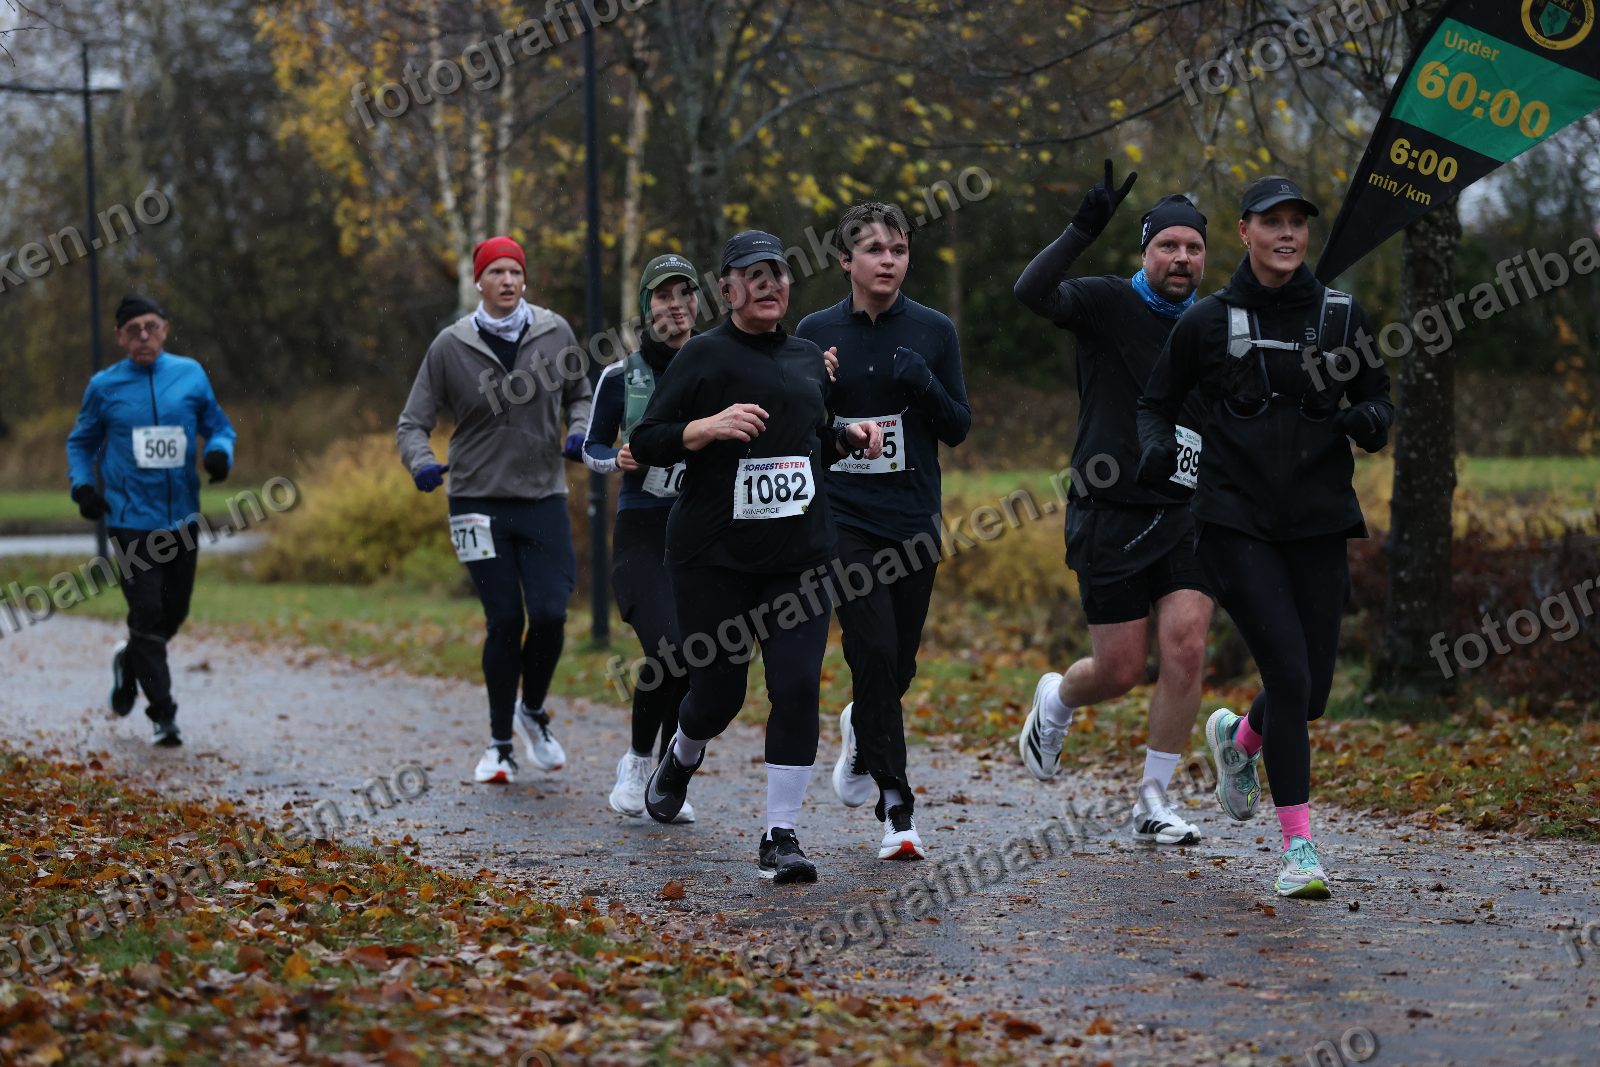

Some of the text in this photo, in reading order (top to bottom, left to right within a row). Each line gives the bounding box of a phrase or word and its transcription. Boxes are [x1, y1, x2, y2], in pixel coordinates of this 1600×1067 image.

[1444, 30, 1500, 61] Under
[1416, 61, 1550, 138] 60:00
[1390, 138, 1458, 183] 6:00
[1368, 171, 1432, 206] min/km
[145, 438, 177, 459] 506
[743, 461, 805, 471] NORGESTESTEN
[743, 472, 808, 504] 1082
